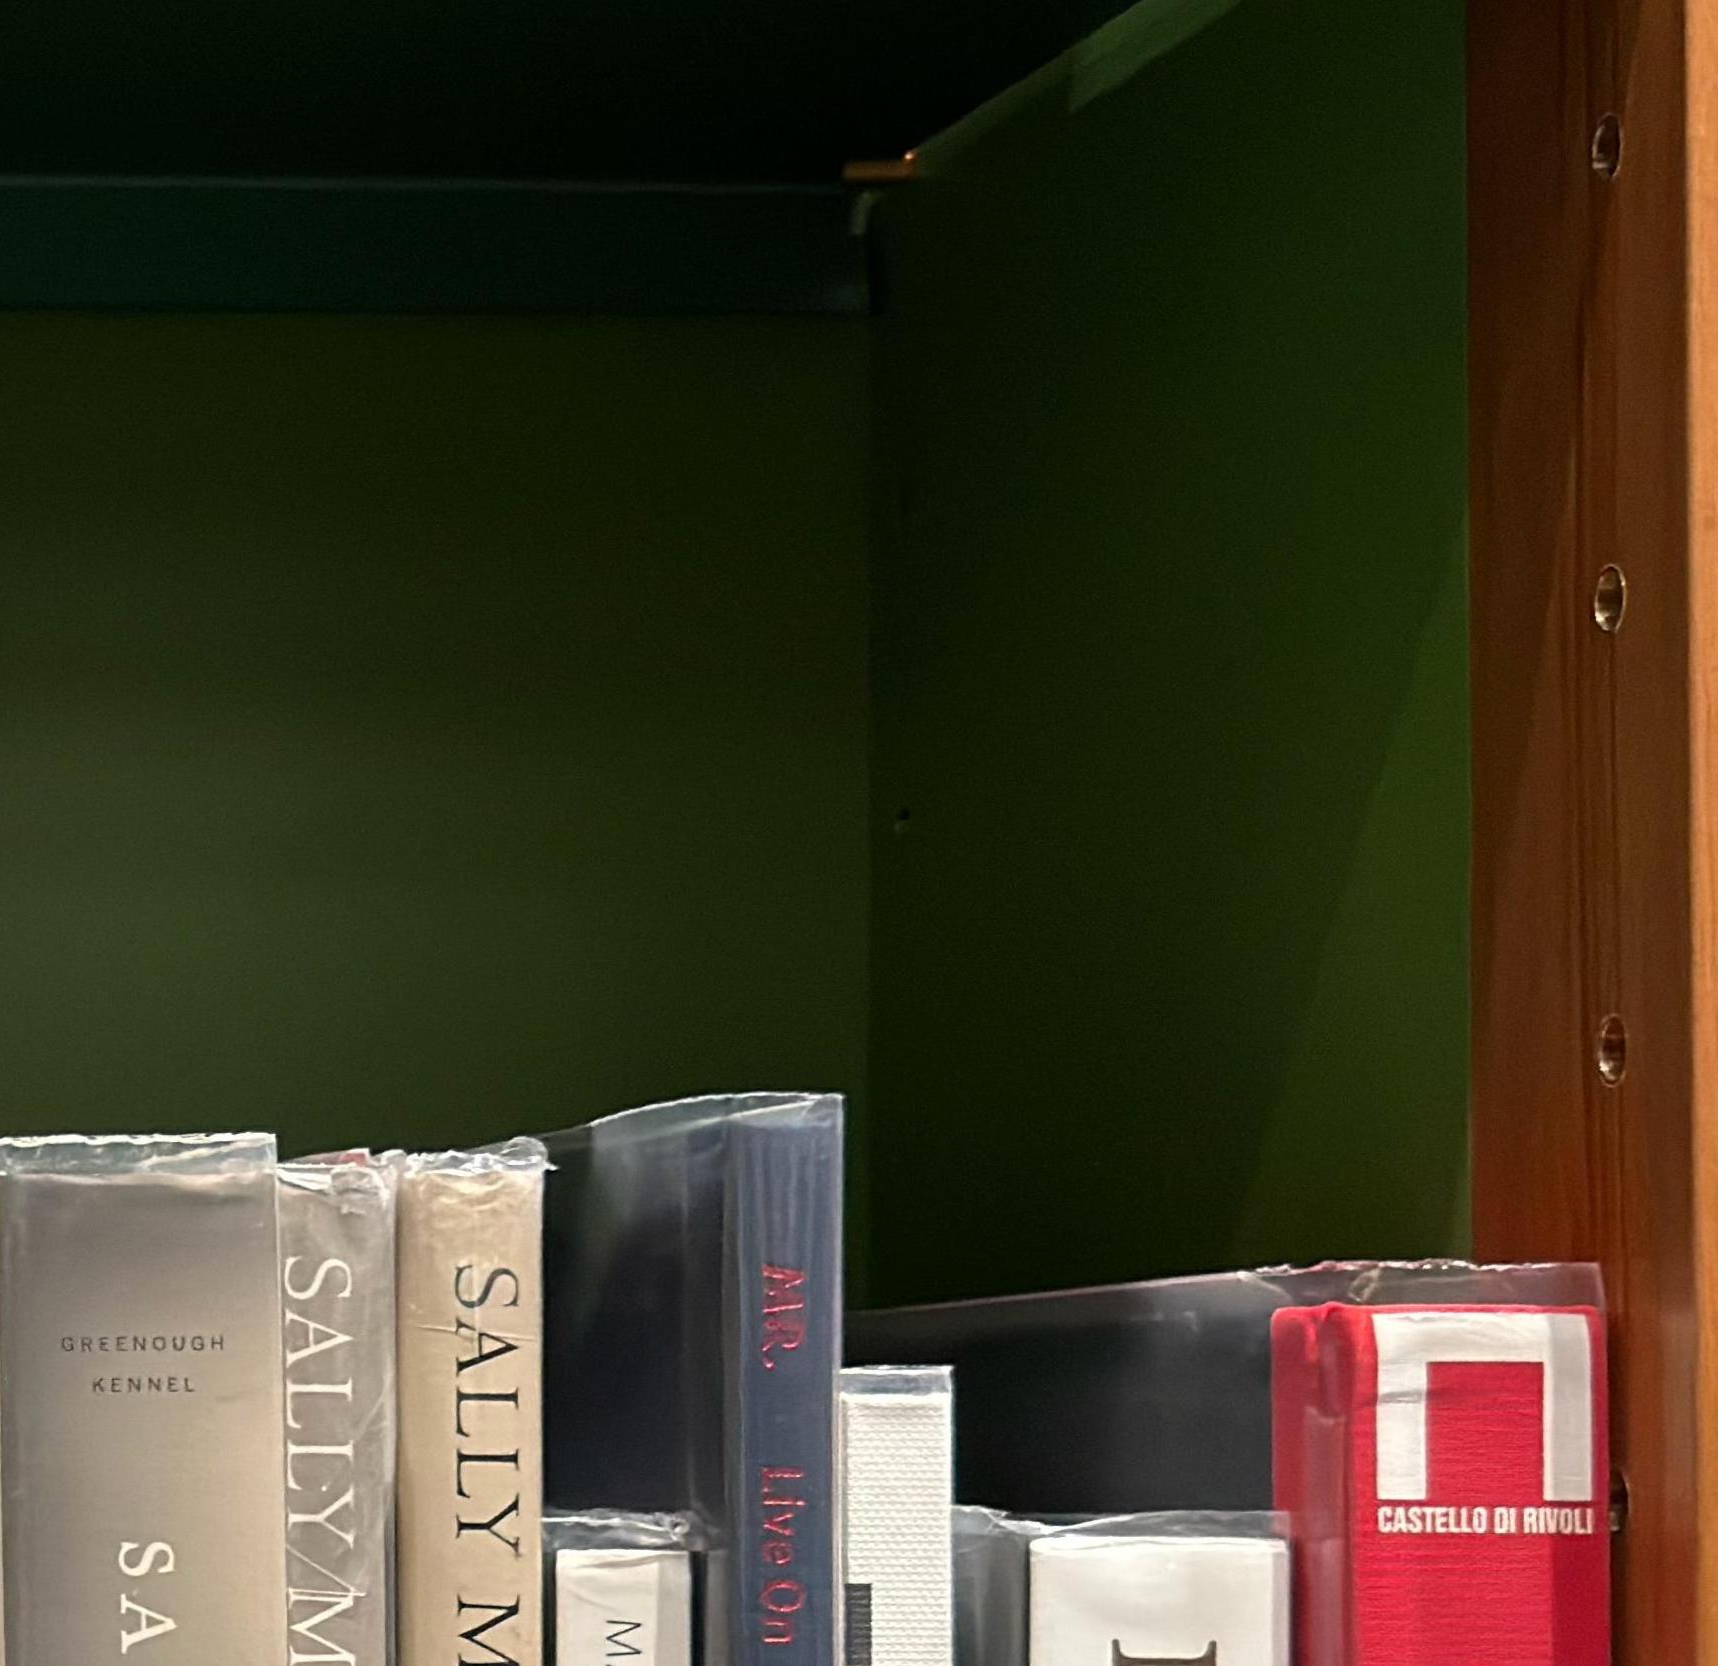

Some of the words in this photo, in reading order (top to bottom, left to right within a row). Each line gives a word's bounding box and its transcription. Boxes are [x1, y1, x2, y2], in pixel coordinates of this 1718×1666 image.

[62, 1335, 226, 1353] GREENOUGH
[92, 1377, 195, 1394] KENNEL
[283, 1255, 355, 1550] SALLY
[454, 1263, 520, 1556] SALLY
[762, 1466, 805, 1564] Live
[1377, 1506, 1488, 1535] CASTELLO
[1494, 1507, 1518, 1534] DI
[1522, 1507, 1593, 1534] RIVOLI
[760, 1587, 806, 1647] On
